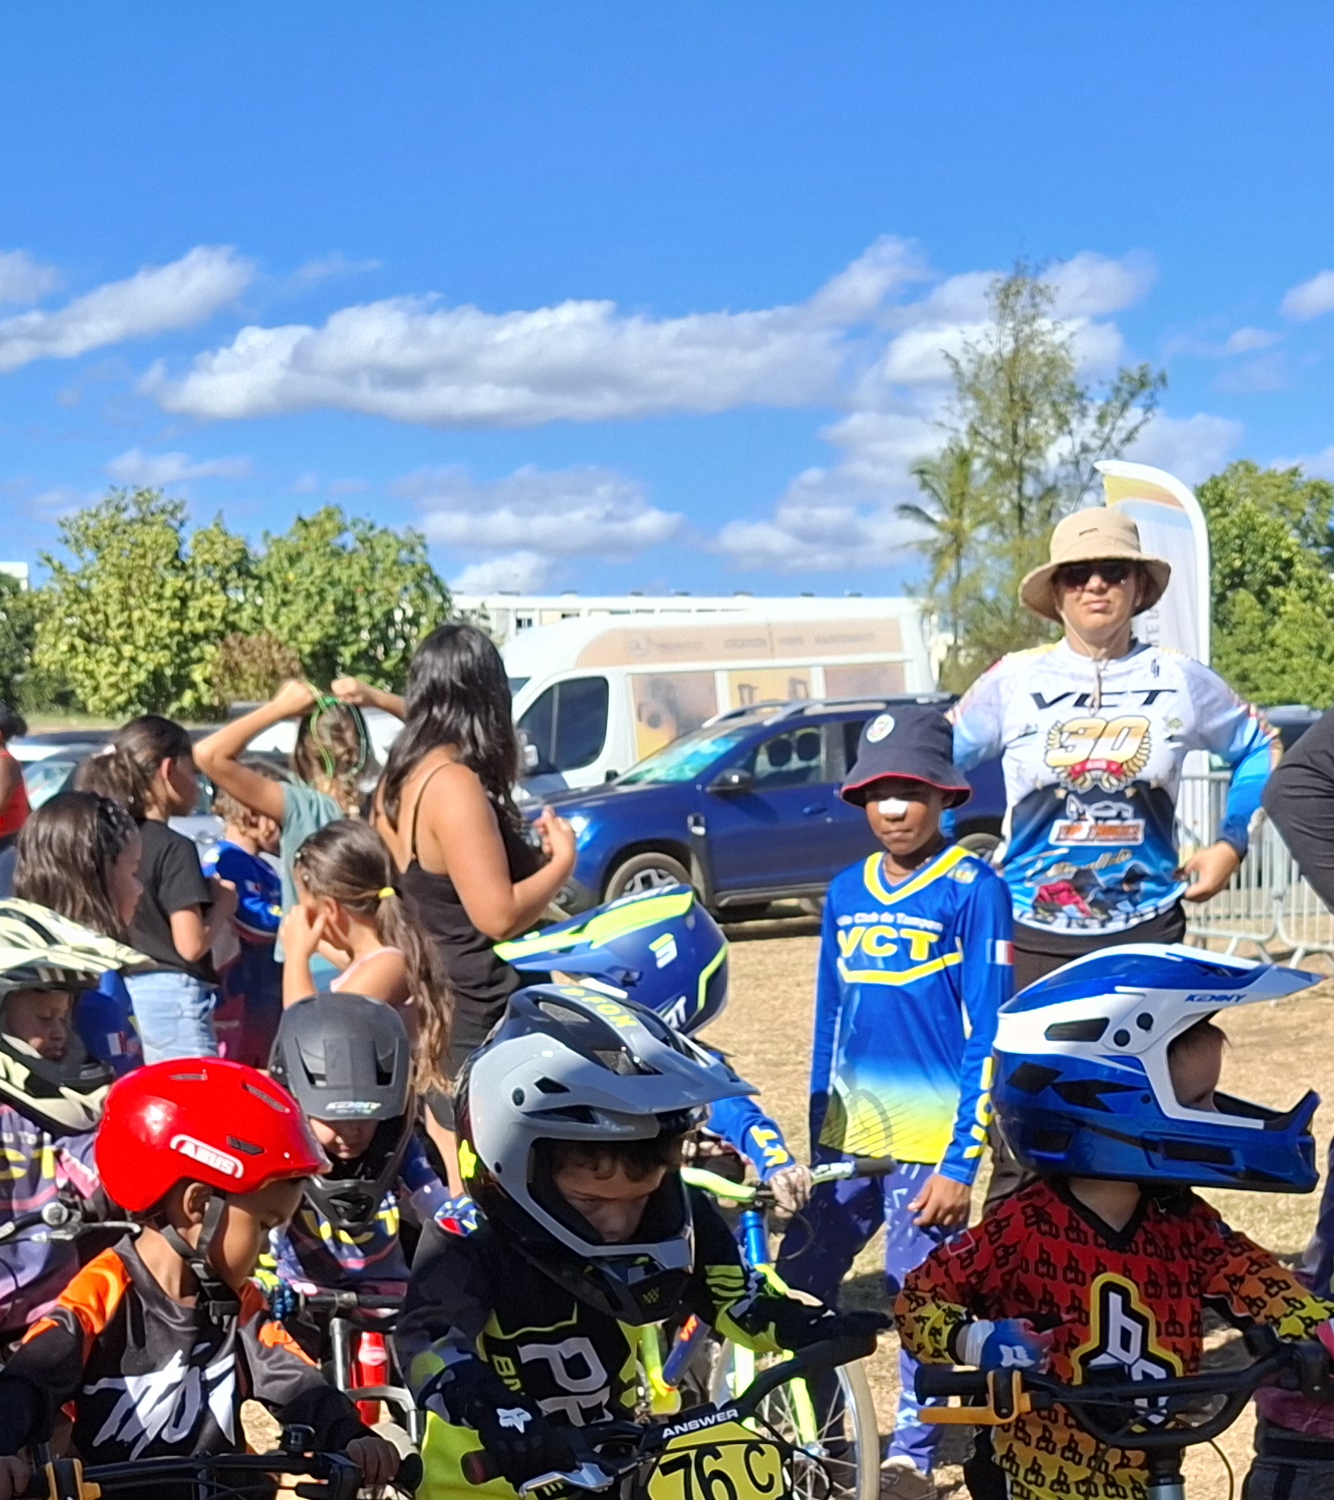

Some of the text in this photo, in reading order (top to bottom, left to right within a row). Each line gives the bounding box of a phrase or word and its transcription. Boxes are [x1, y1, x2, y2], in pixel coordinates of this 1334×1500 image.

[1030, 689, 1177, 710] VCT
[1044, 715, 1151, 768] 30
[837, 925, 940, 961] VCT
[581, 995, 638, 1028] FOX
[1184, 994, 1248, 1003] KENNY
[662, 1408, 740, 1439] ANSWER
